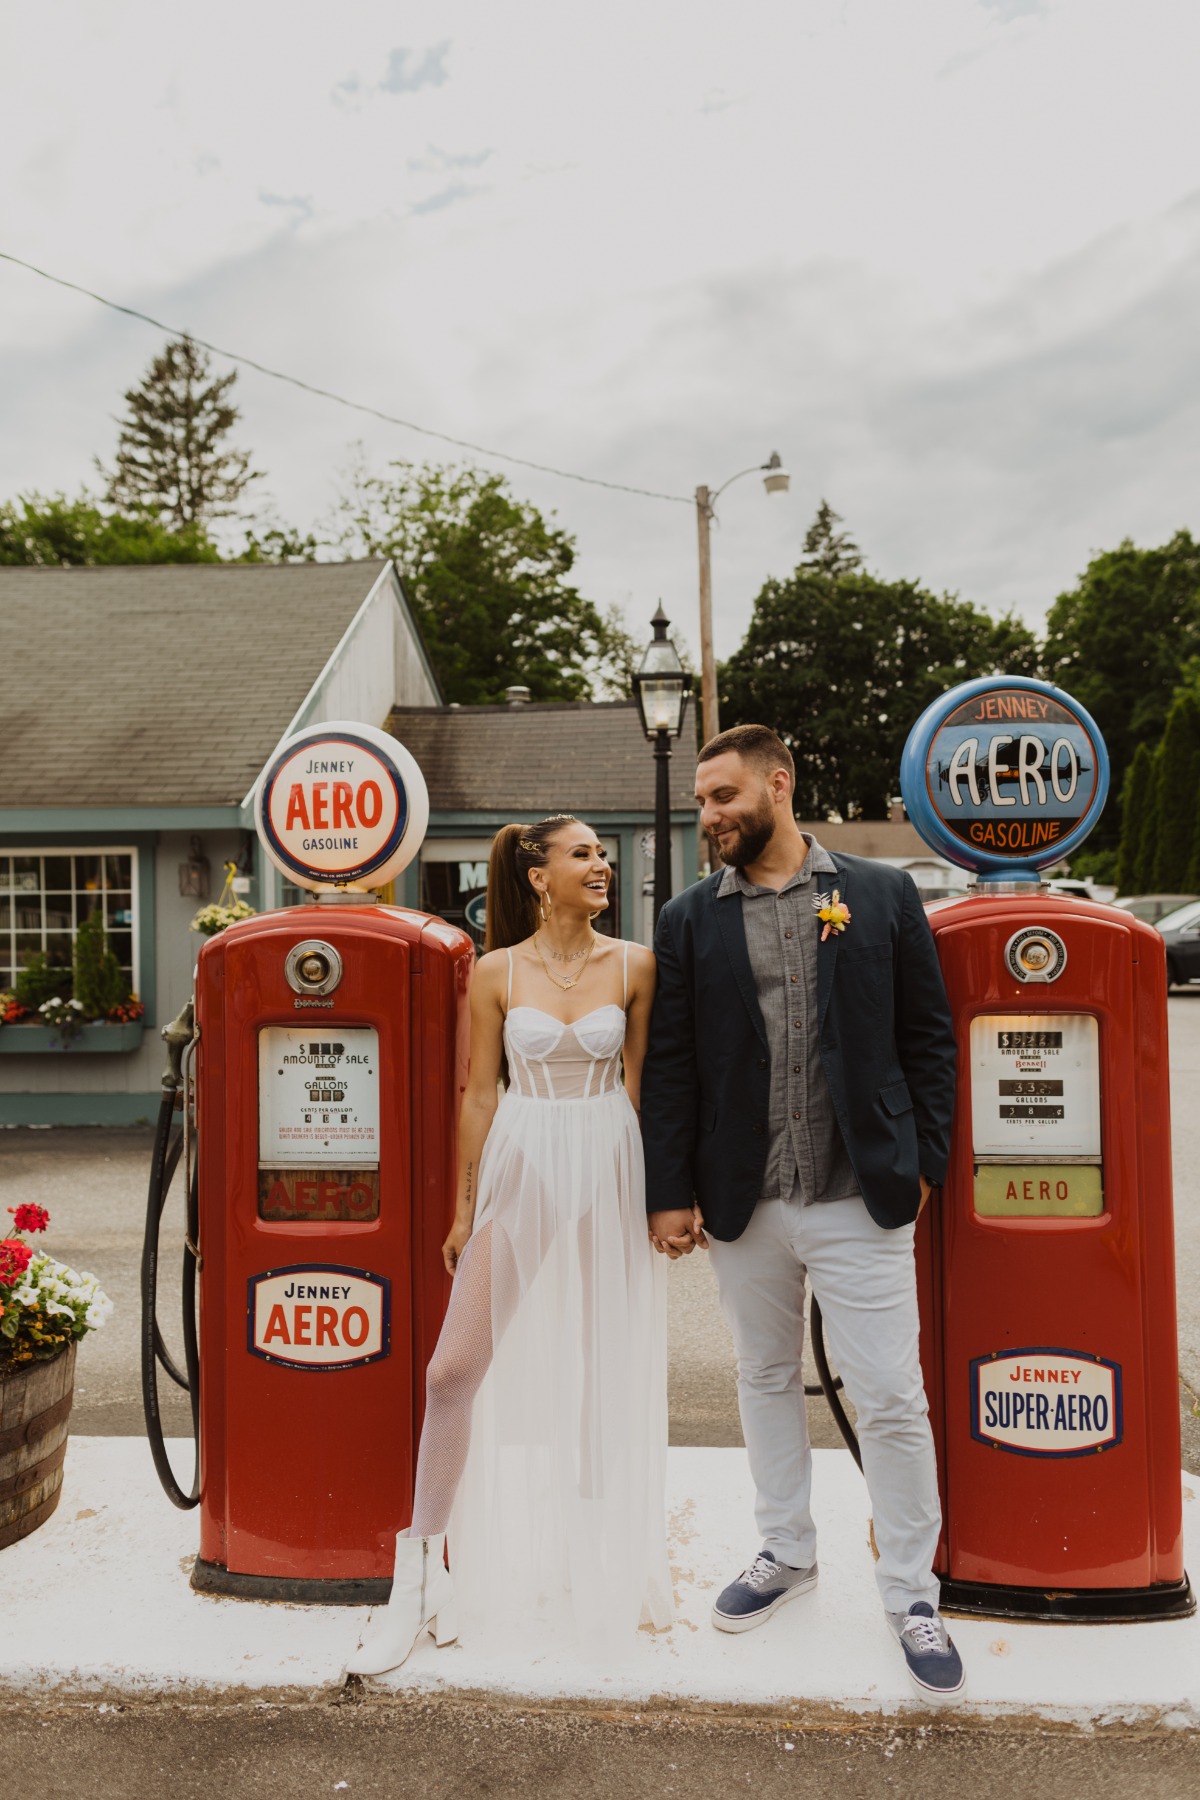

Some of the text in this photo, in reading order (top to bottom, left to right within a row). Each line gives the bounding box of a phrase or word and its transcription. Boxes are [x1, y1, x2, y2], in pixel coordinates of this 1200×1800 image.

[975, 697, 1048, 720] JENNEY
[306, 760, 354, 774] JENNEY
[948, 735, 1078, 806] AERO
[286, 780, 383, 830] AERO
[303, 838, 359, 850] GASOLINE
[970, 822, 1060, 848] GASOLINE
[284, 1056, 369, 1064] AMOUNT OF SALE
[264, 1181, 373, 1212] AERO
[1006, 1181, 1068, 1200] AERO
[284, 1282, 351, 1299] JENNEY
[263, 1304, 369, 1347] AERO
[1010, 1366, 1082, 1383] JENNEY
